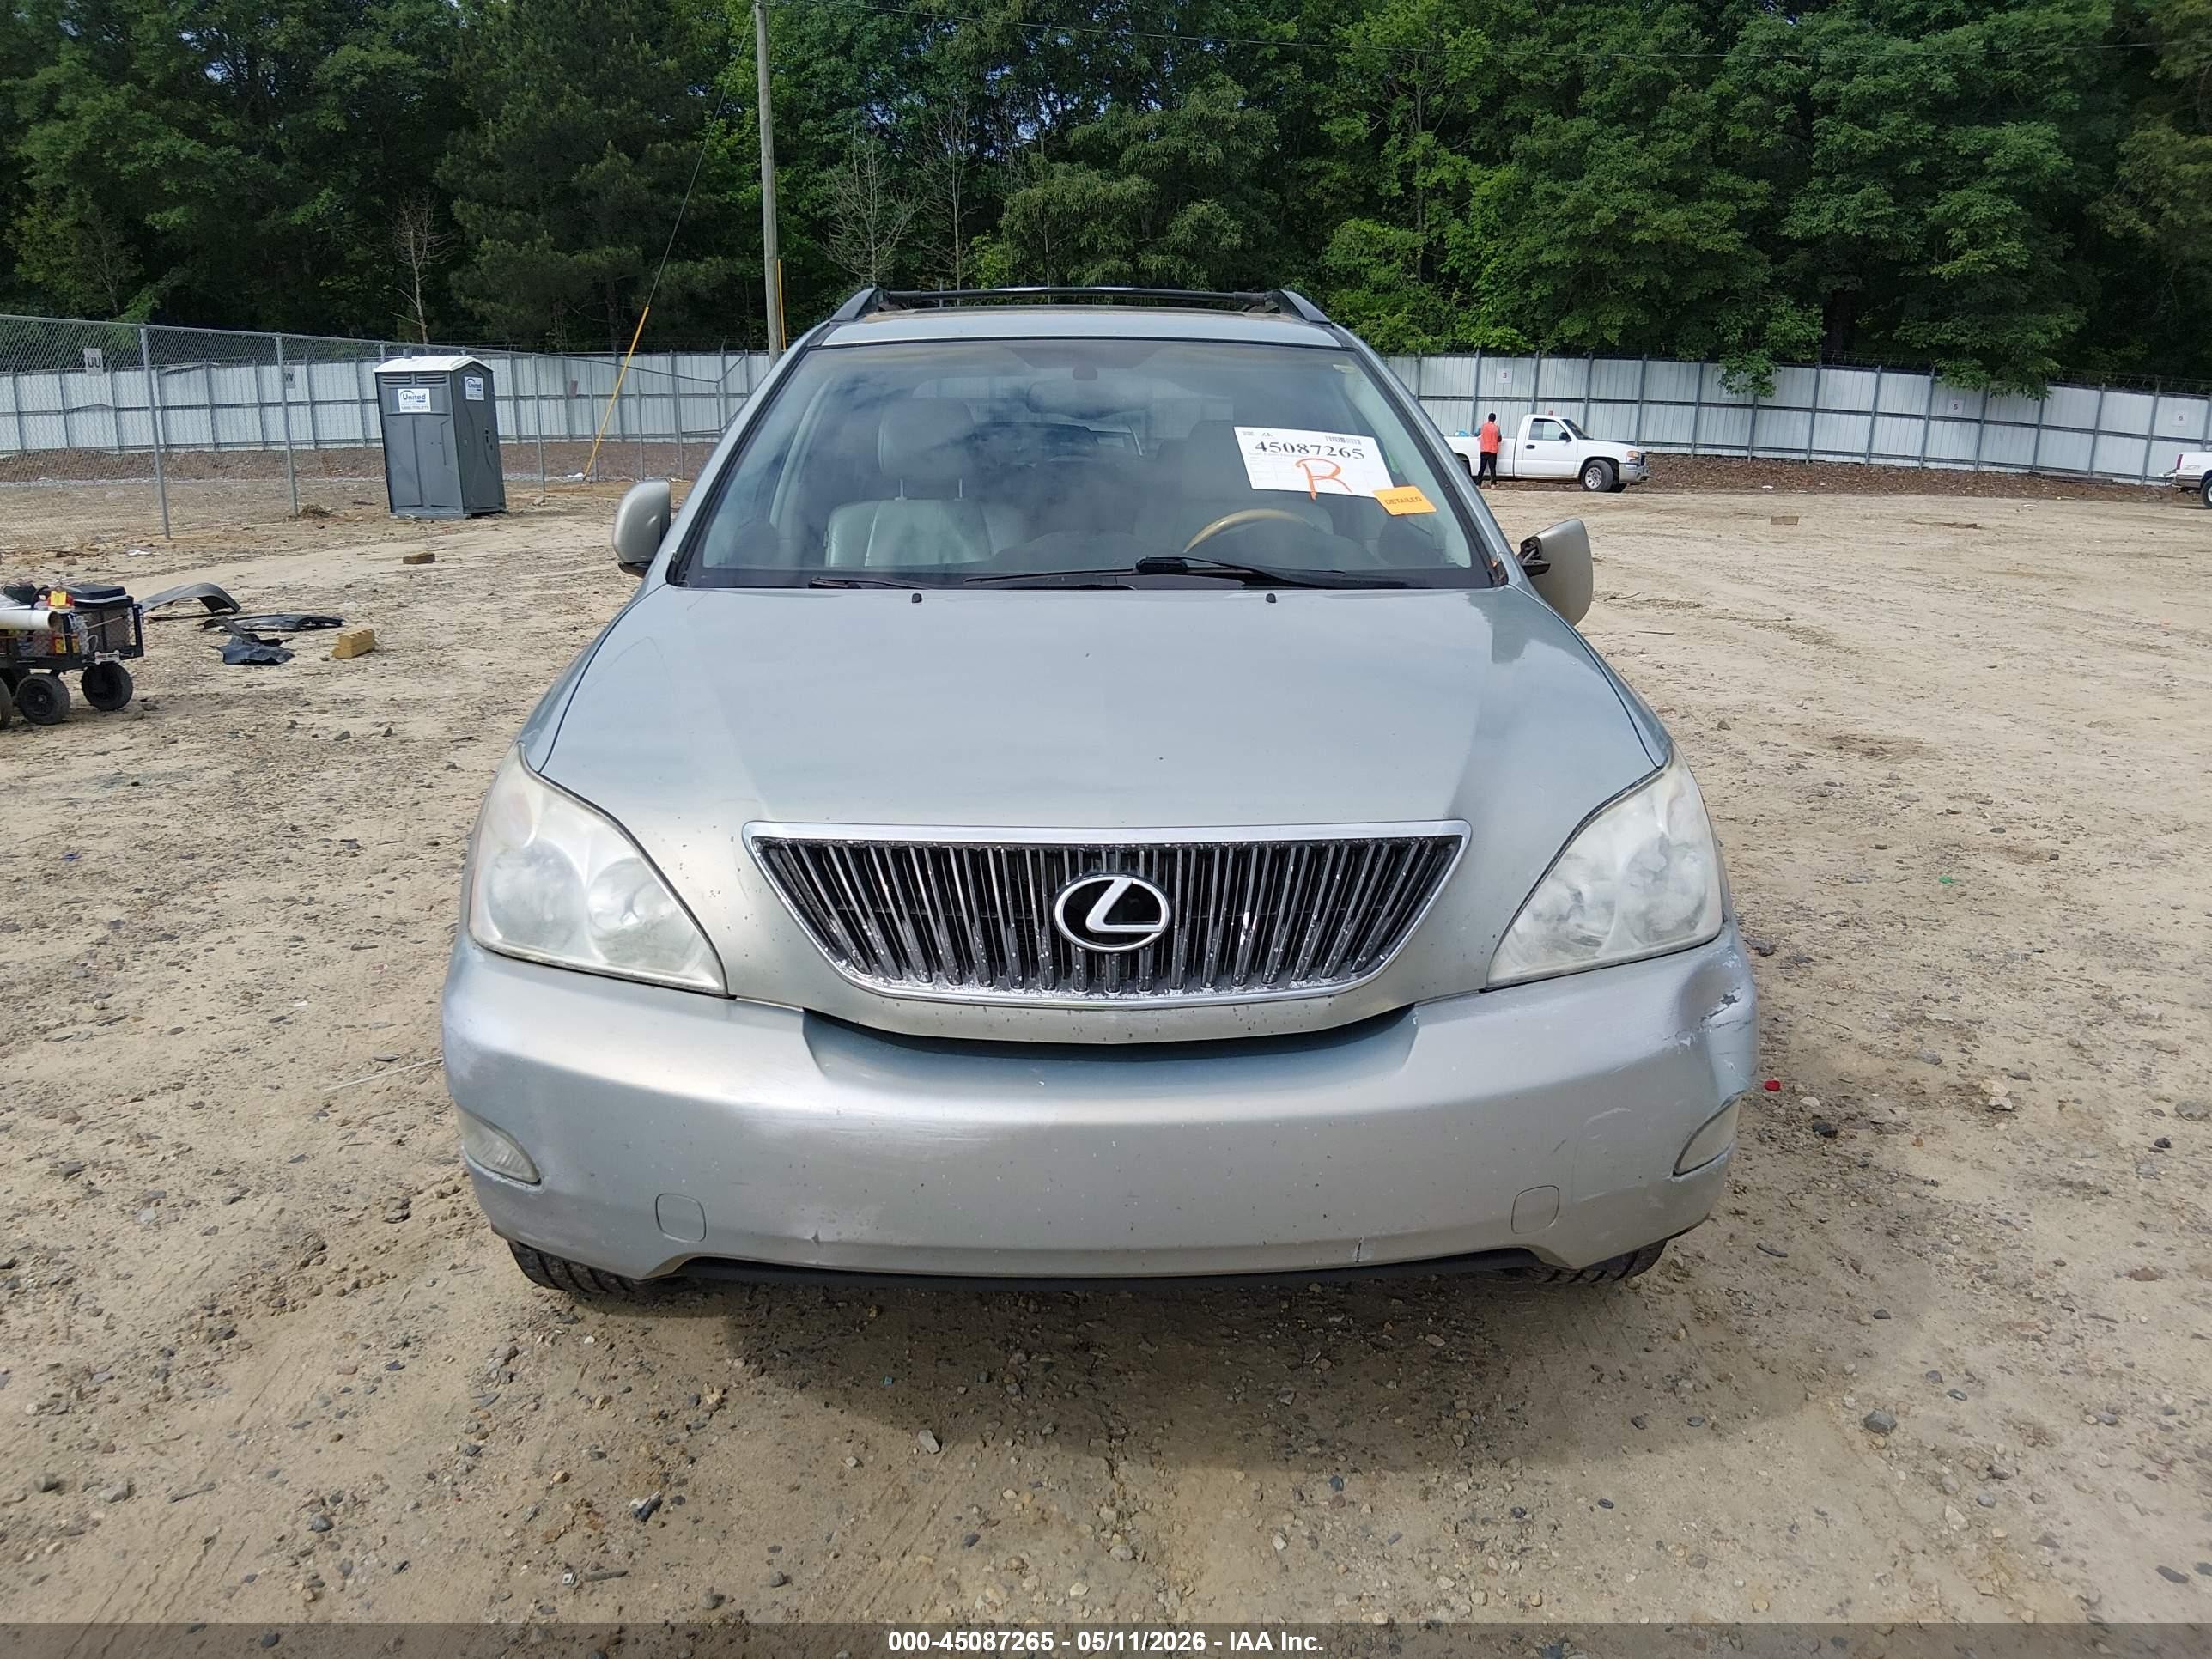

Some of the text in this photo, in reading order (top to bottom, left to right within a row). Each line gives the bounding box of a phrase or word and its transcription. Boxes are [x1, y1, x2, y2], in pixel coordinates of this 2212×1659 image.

[87, 356, 101, 368] UU
[1255, 441, 1364, 460] 45087265
[1295, 458, 1352, 501] R
[1383, 496, 1423, 505] DETAILED
